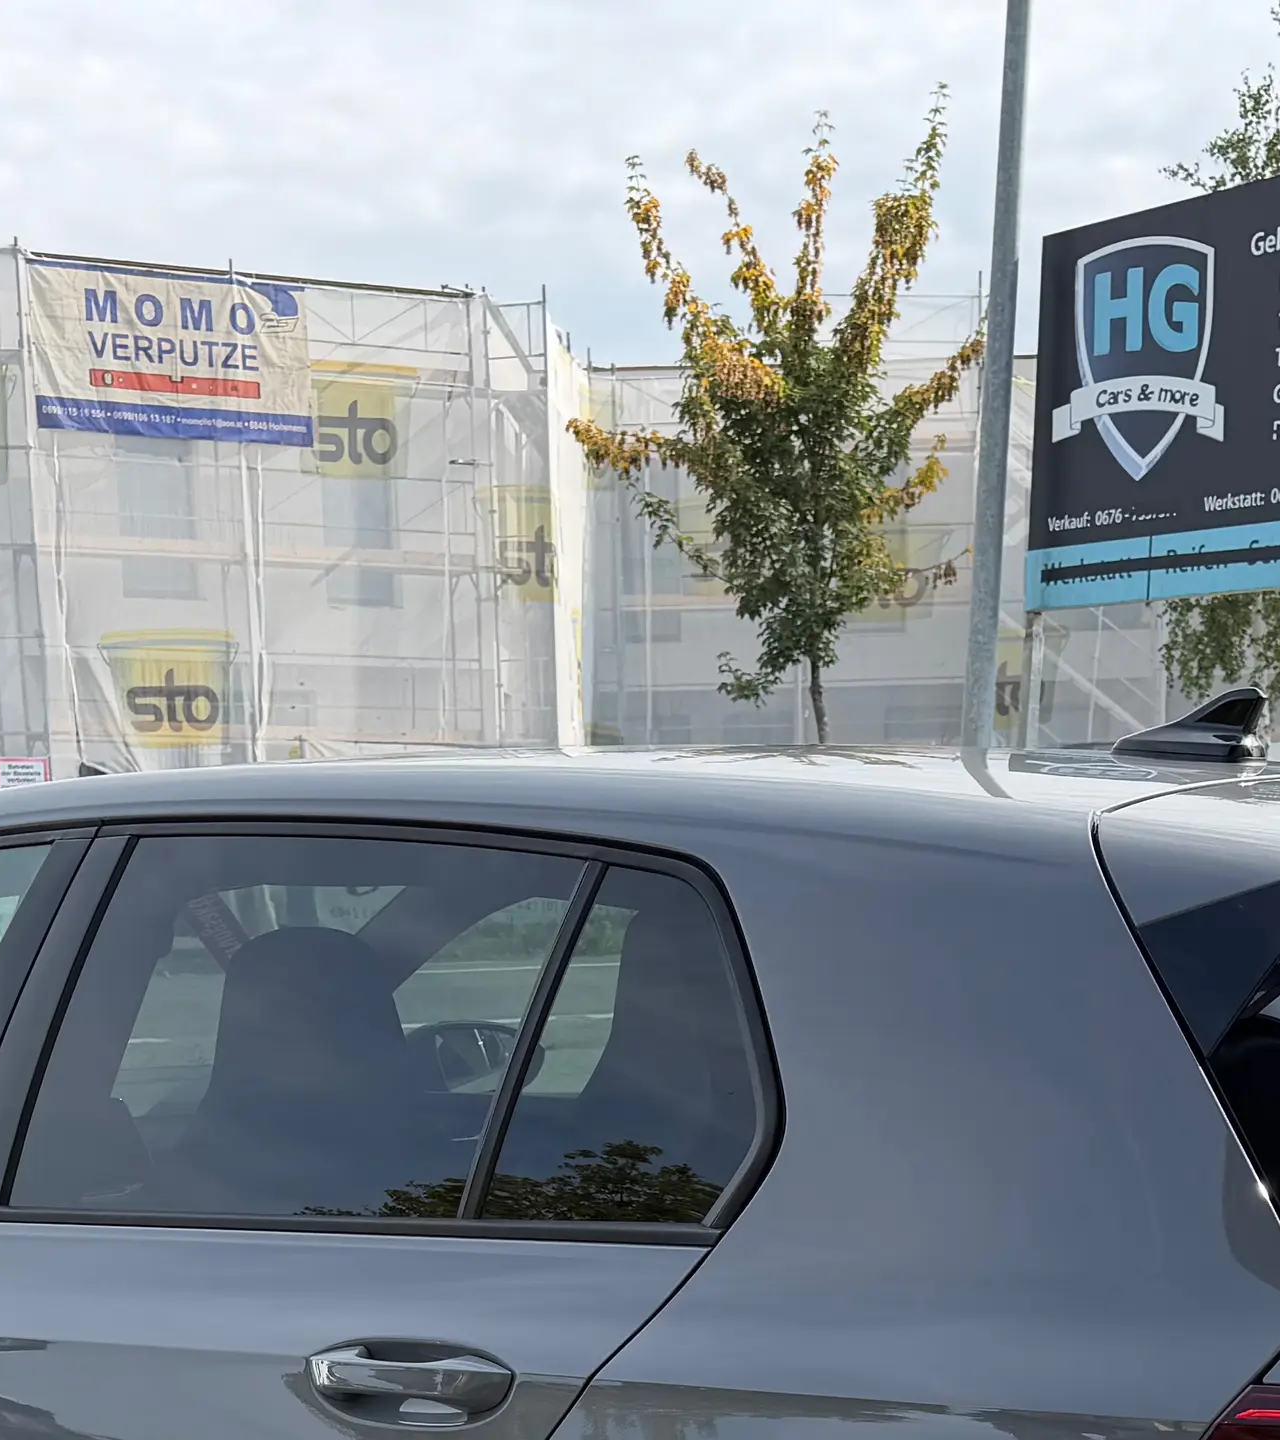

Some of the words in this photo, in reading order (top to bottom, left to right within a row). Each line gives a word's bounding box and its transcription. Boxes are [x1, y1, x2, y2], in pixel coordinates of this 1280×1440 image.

[84, 287, 256, 336] MOMO
[1093, 263, 1200, 357] HG
[88, 330, 260, 372] VERPUTZE
[1095, 387, 1132, 408] Cars
[1137, 384, 1154, 402] &
[1157, 387, 1200, 407] more
[316, 400, 398, 465] sto
[1047, 511, 1091, 532] Verkauf:
[1095, 508, 1123, 526] 0676
[1204, 492, 1265, 512] Werkstatt:
[499, 524, 557, 587] st
[126, 668, 219, 732] sto
